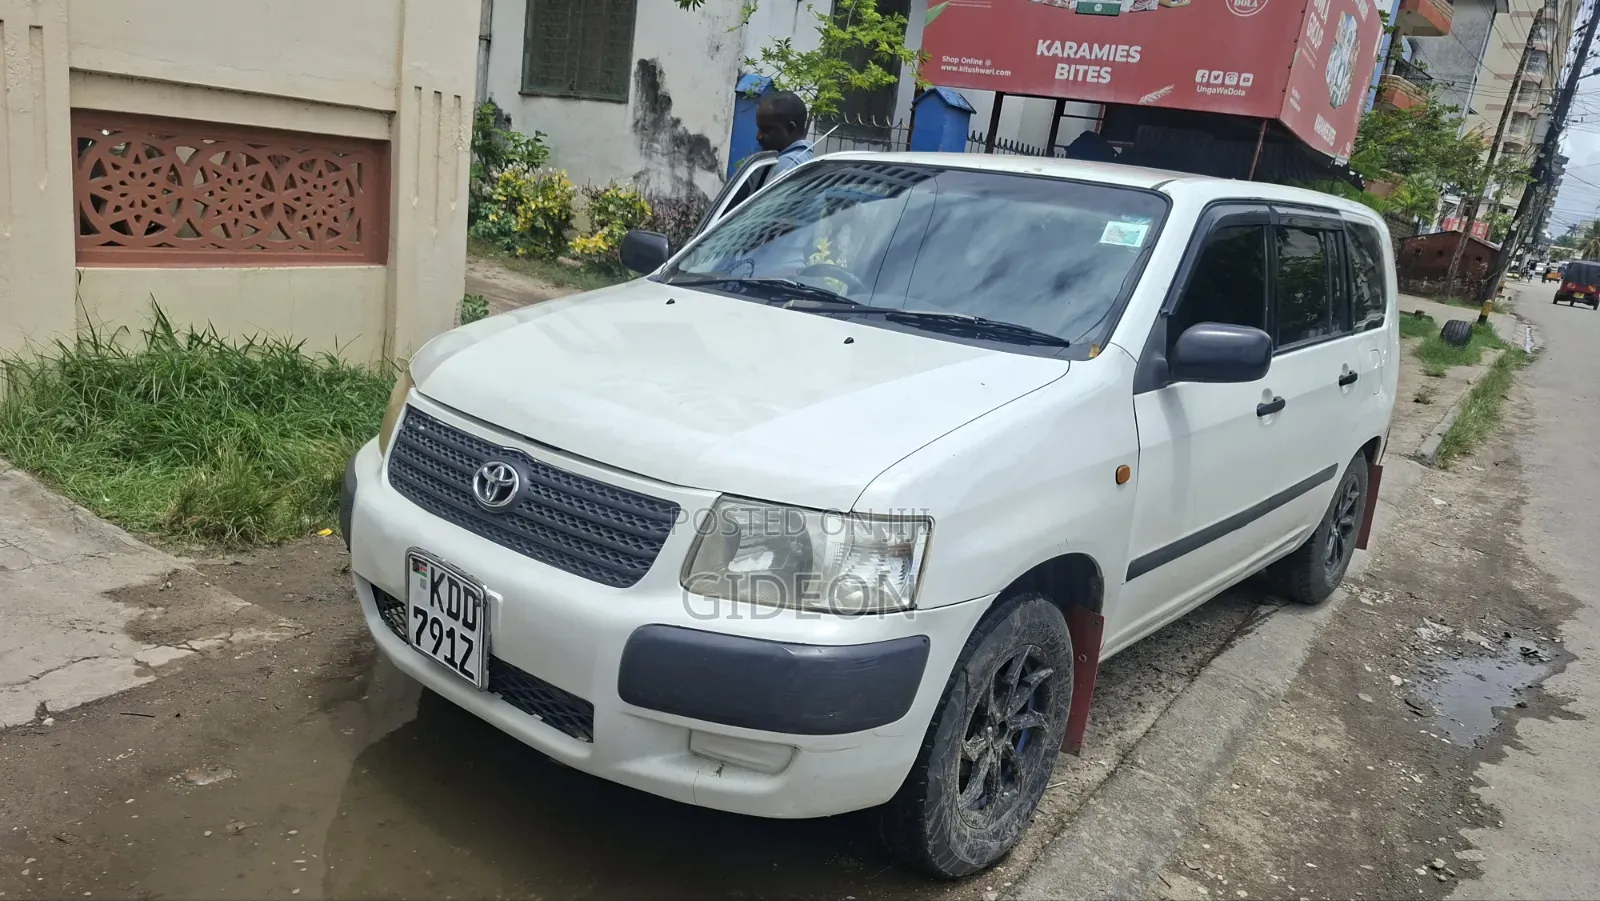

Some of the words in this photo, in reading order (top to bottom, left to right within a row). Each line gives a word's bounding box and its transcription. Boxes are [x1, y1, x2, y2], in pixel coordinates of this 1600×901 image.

[942, 55, 959, 64] Shop
[961, 57, 984, 66] Online
[1036, 39, 1142, 63] KARAMIES
[940, 64, 1012, 77] www.kitushwari.com
[1054, 63, 1112, 84] BITES
[1196, 84, 1246, 96] UngaWaDola
[429, 566, 478, 632] KDD
[413, 605, 476, 681] 791Z
